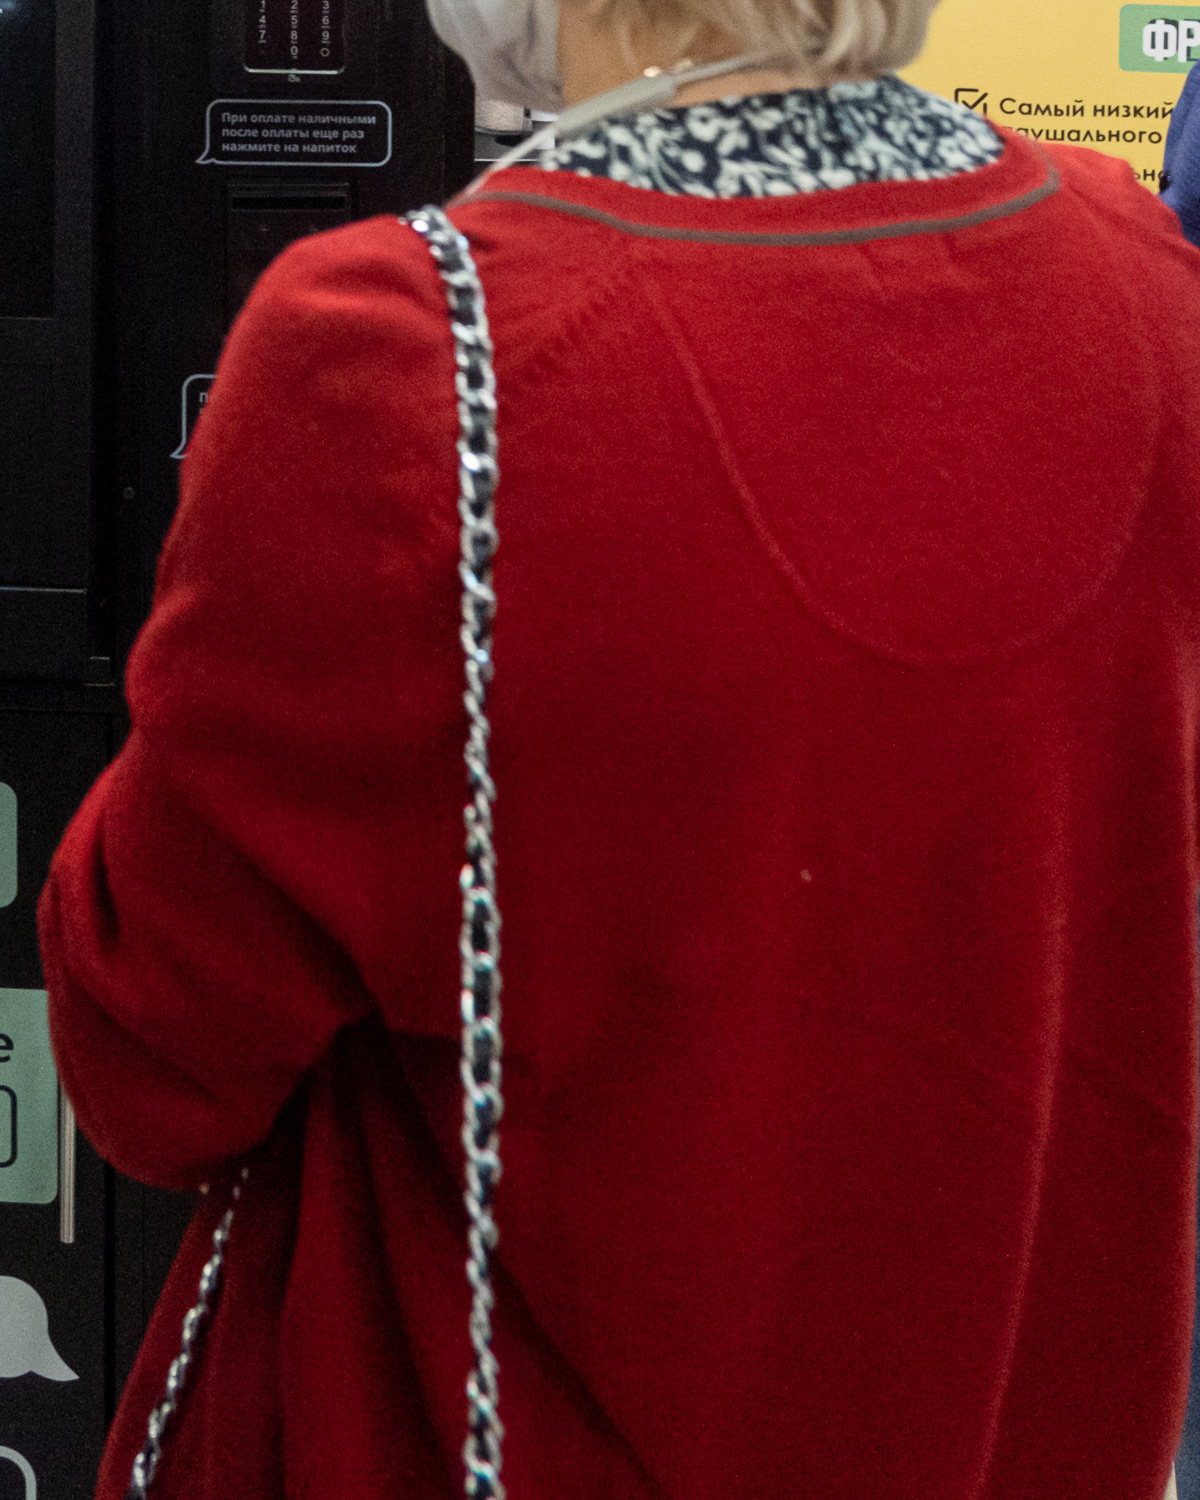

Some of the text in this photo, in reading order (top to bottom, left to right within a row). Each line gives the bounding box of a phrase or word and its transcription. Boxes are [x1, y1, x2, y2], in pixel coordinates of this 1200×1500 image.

[290, 0, 298, 9] 2
[321, 0, 330, 10] 3
[258, 15, 330, 25] 4 5 6
[259, 30, 330, 41] 7 8 9
[290, 45, 298, 56] 0
[999, 97, 1174, 119] Самый низкий
[221, 113, 377, 125] При оплате наличными
[221, 128, 365, 141] после оплаты еще раз
[1006, 127, 1163, 144] аушального
[221, 142, 357, 154] нажмите на напиток
